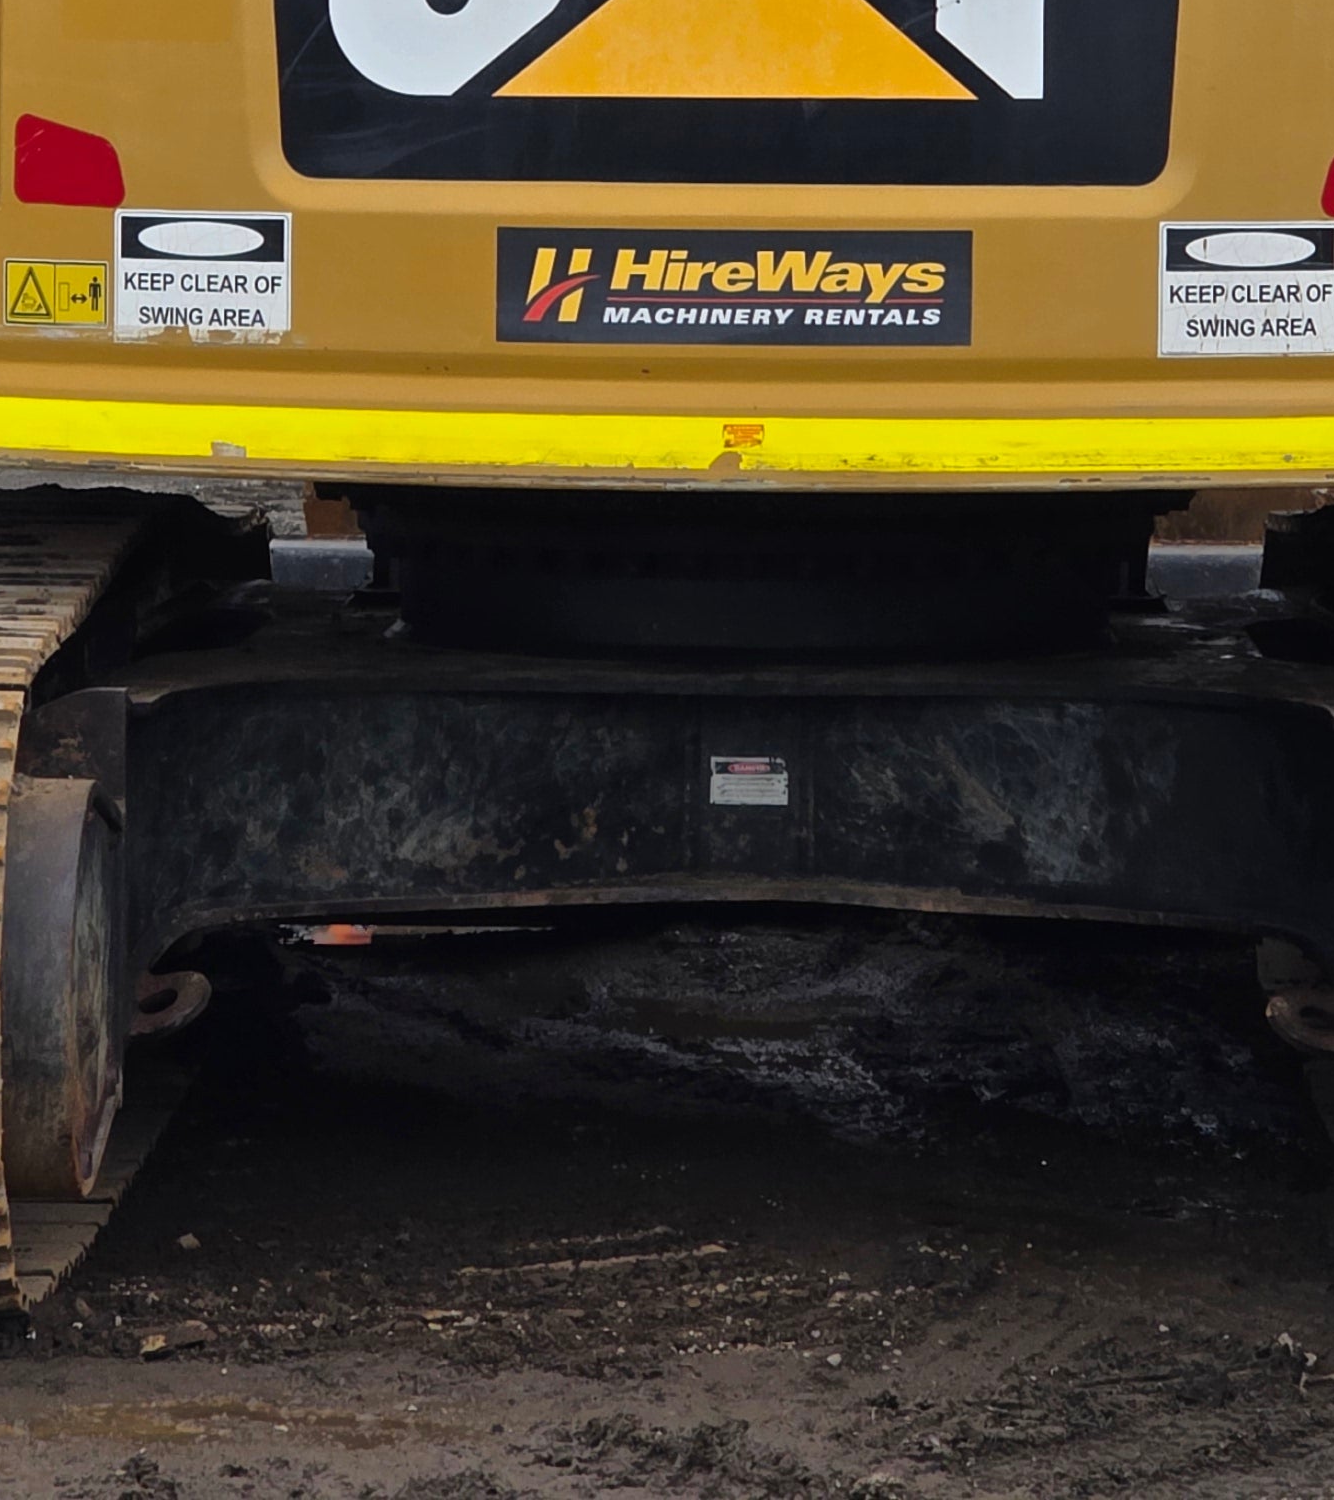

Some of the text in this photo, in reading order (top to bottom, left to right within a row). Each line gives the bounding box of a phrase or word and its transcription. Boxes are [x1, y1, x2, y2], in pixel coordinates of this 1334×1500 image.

[124, 272, 282, 295] KEEP CLEAR OF
[610, 249, 945, 303] HireWays
[1169, 283, 1333, 303] KEEP CLEAR OF
[139, 306, 266, 327] SWING AREA
[603, 306, 941, 327] MACHINERY RENTALS
[1186, 318, 1317, 338] SWING AREA
